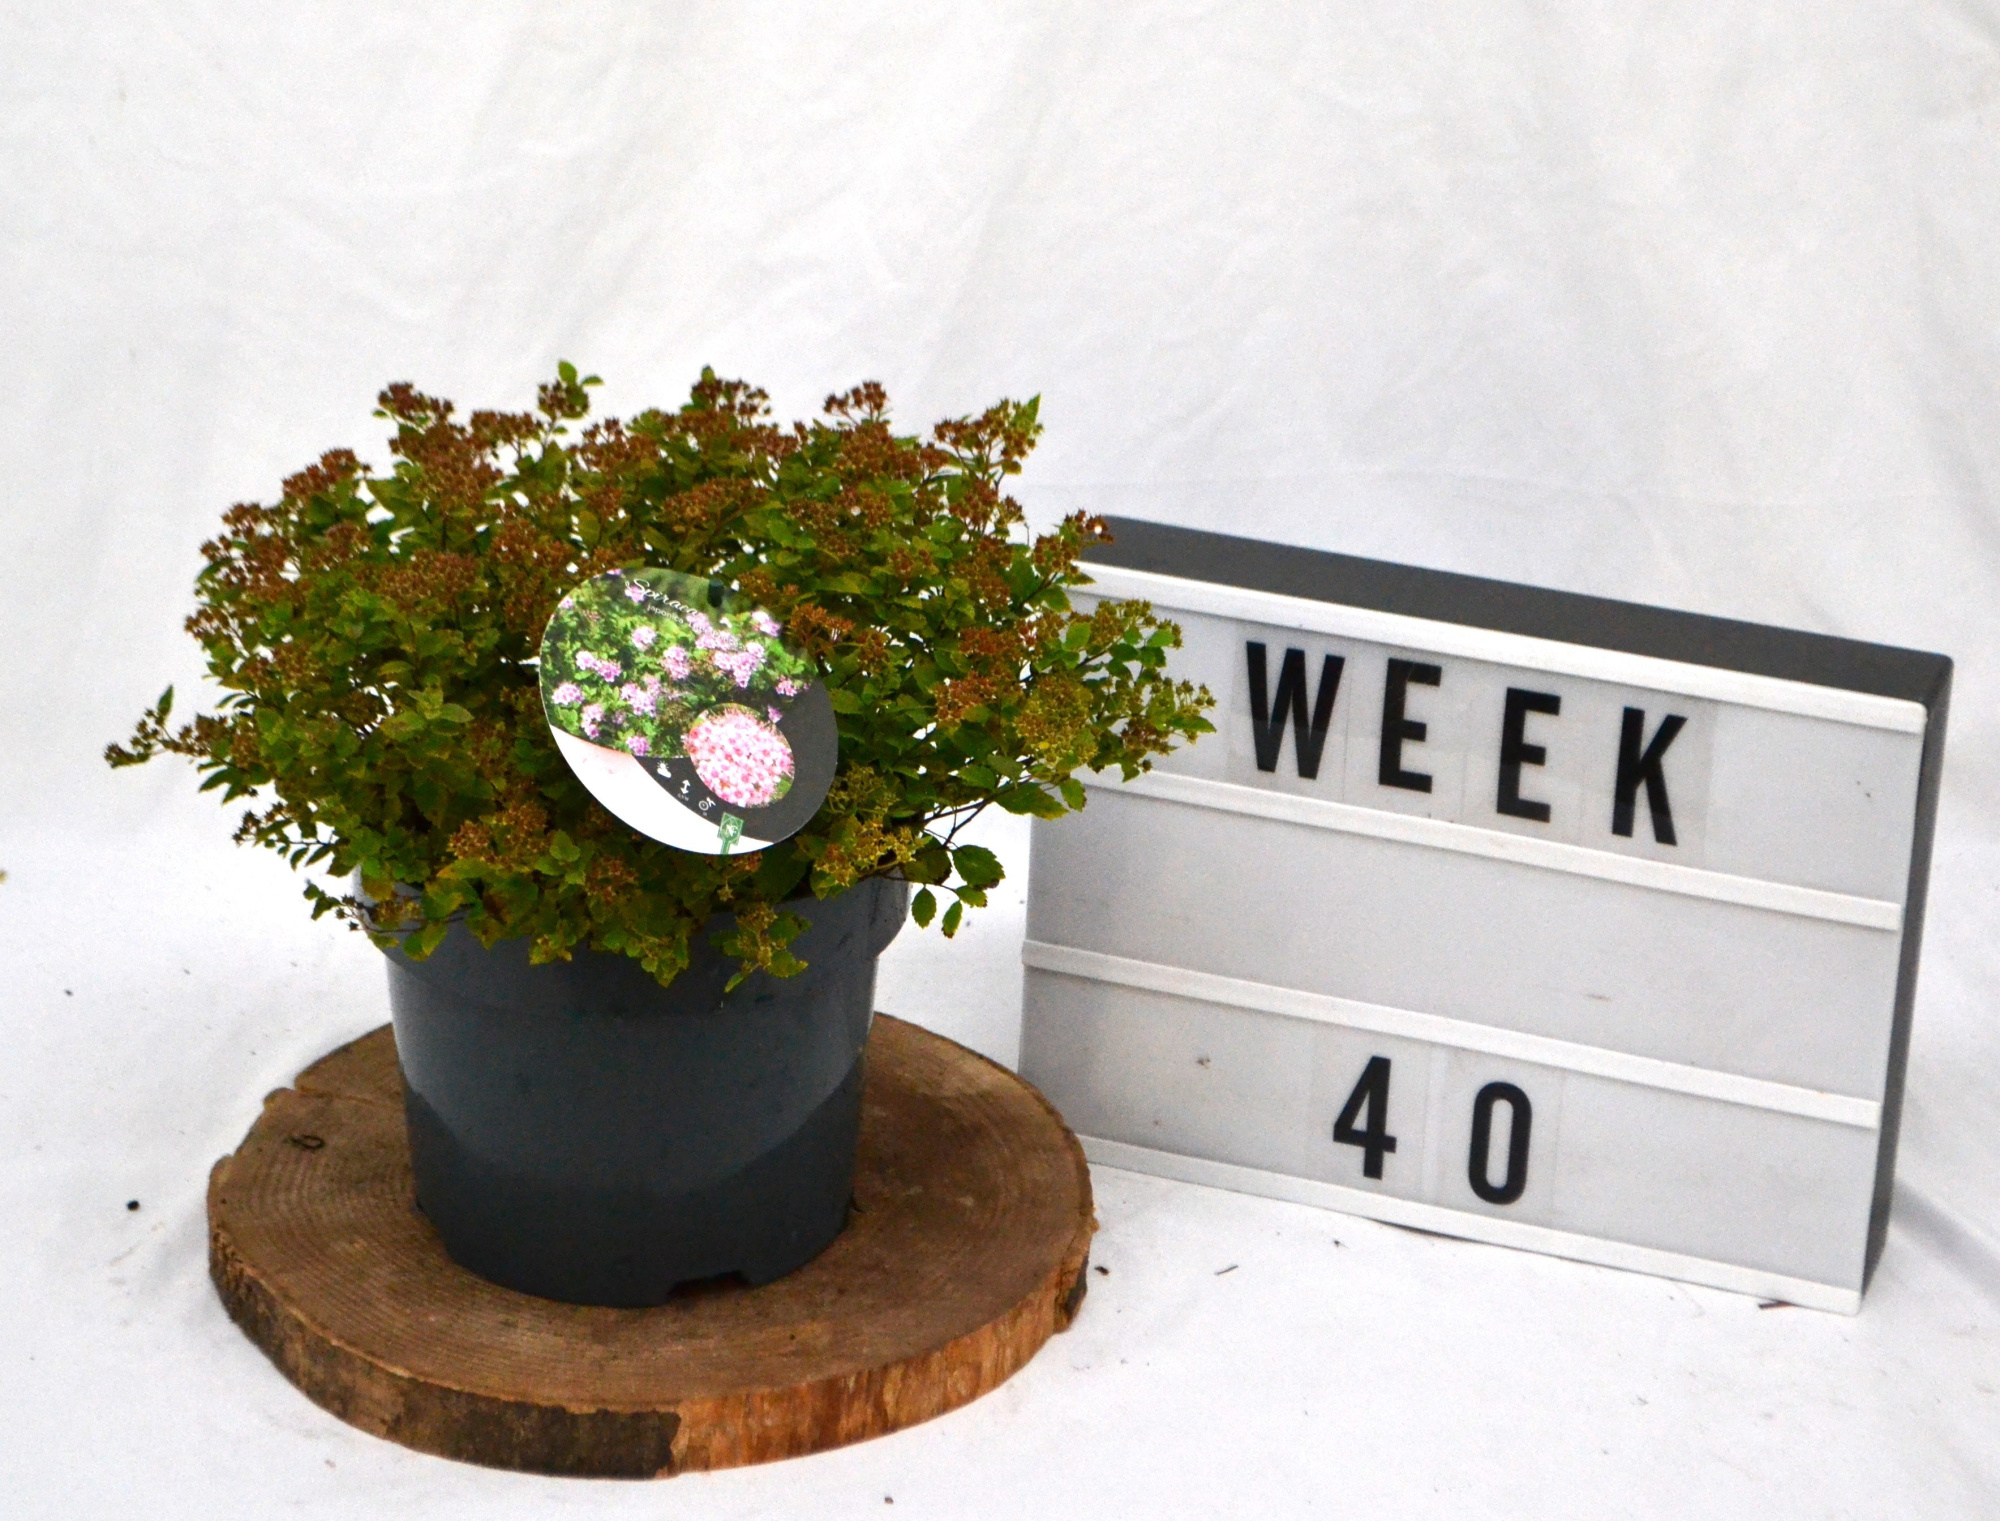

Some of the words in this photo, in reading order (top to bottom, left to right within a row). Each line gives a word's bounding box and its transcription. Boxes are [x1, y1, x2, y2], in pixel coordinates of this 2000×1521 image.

[647, 603, 685, 624] japonica
[1245, 640, 1688, 847] WEEK
[1332, 1055, 1533, 1206] 40
